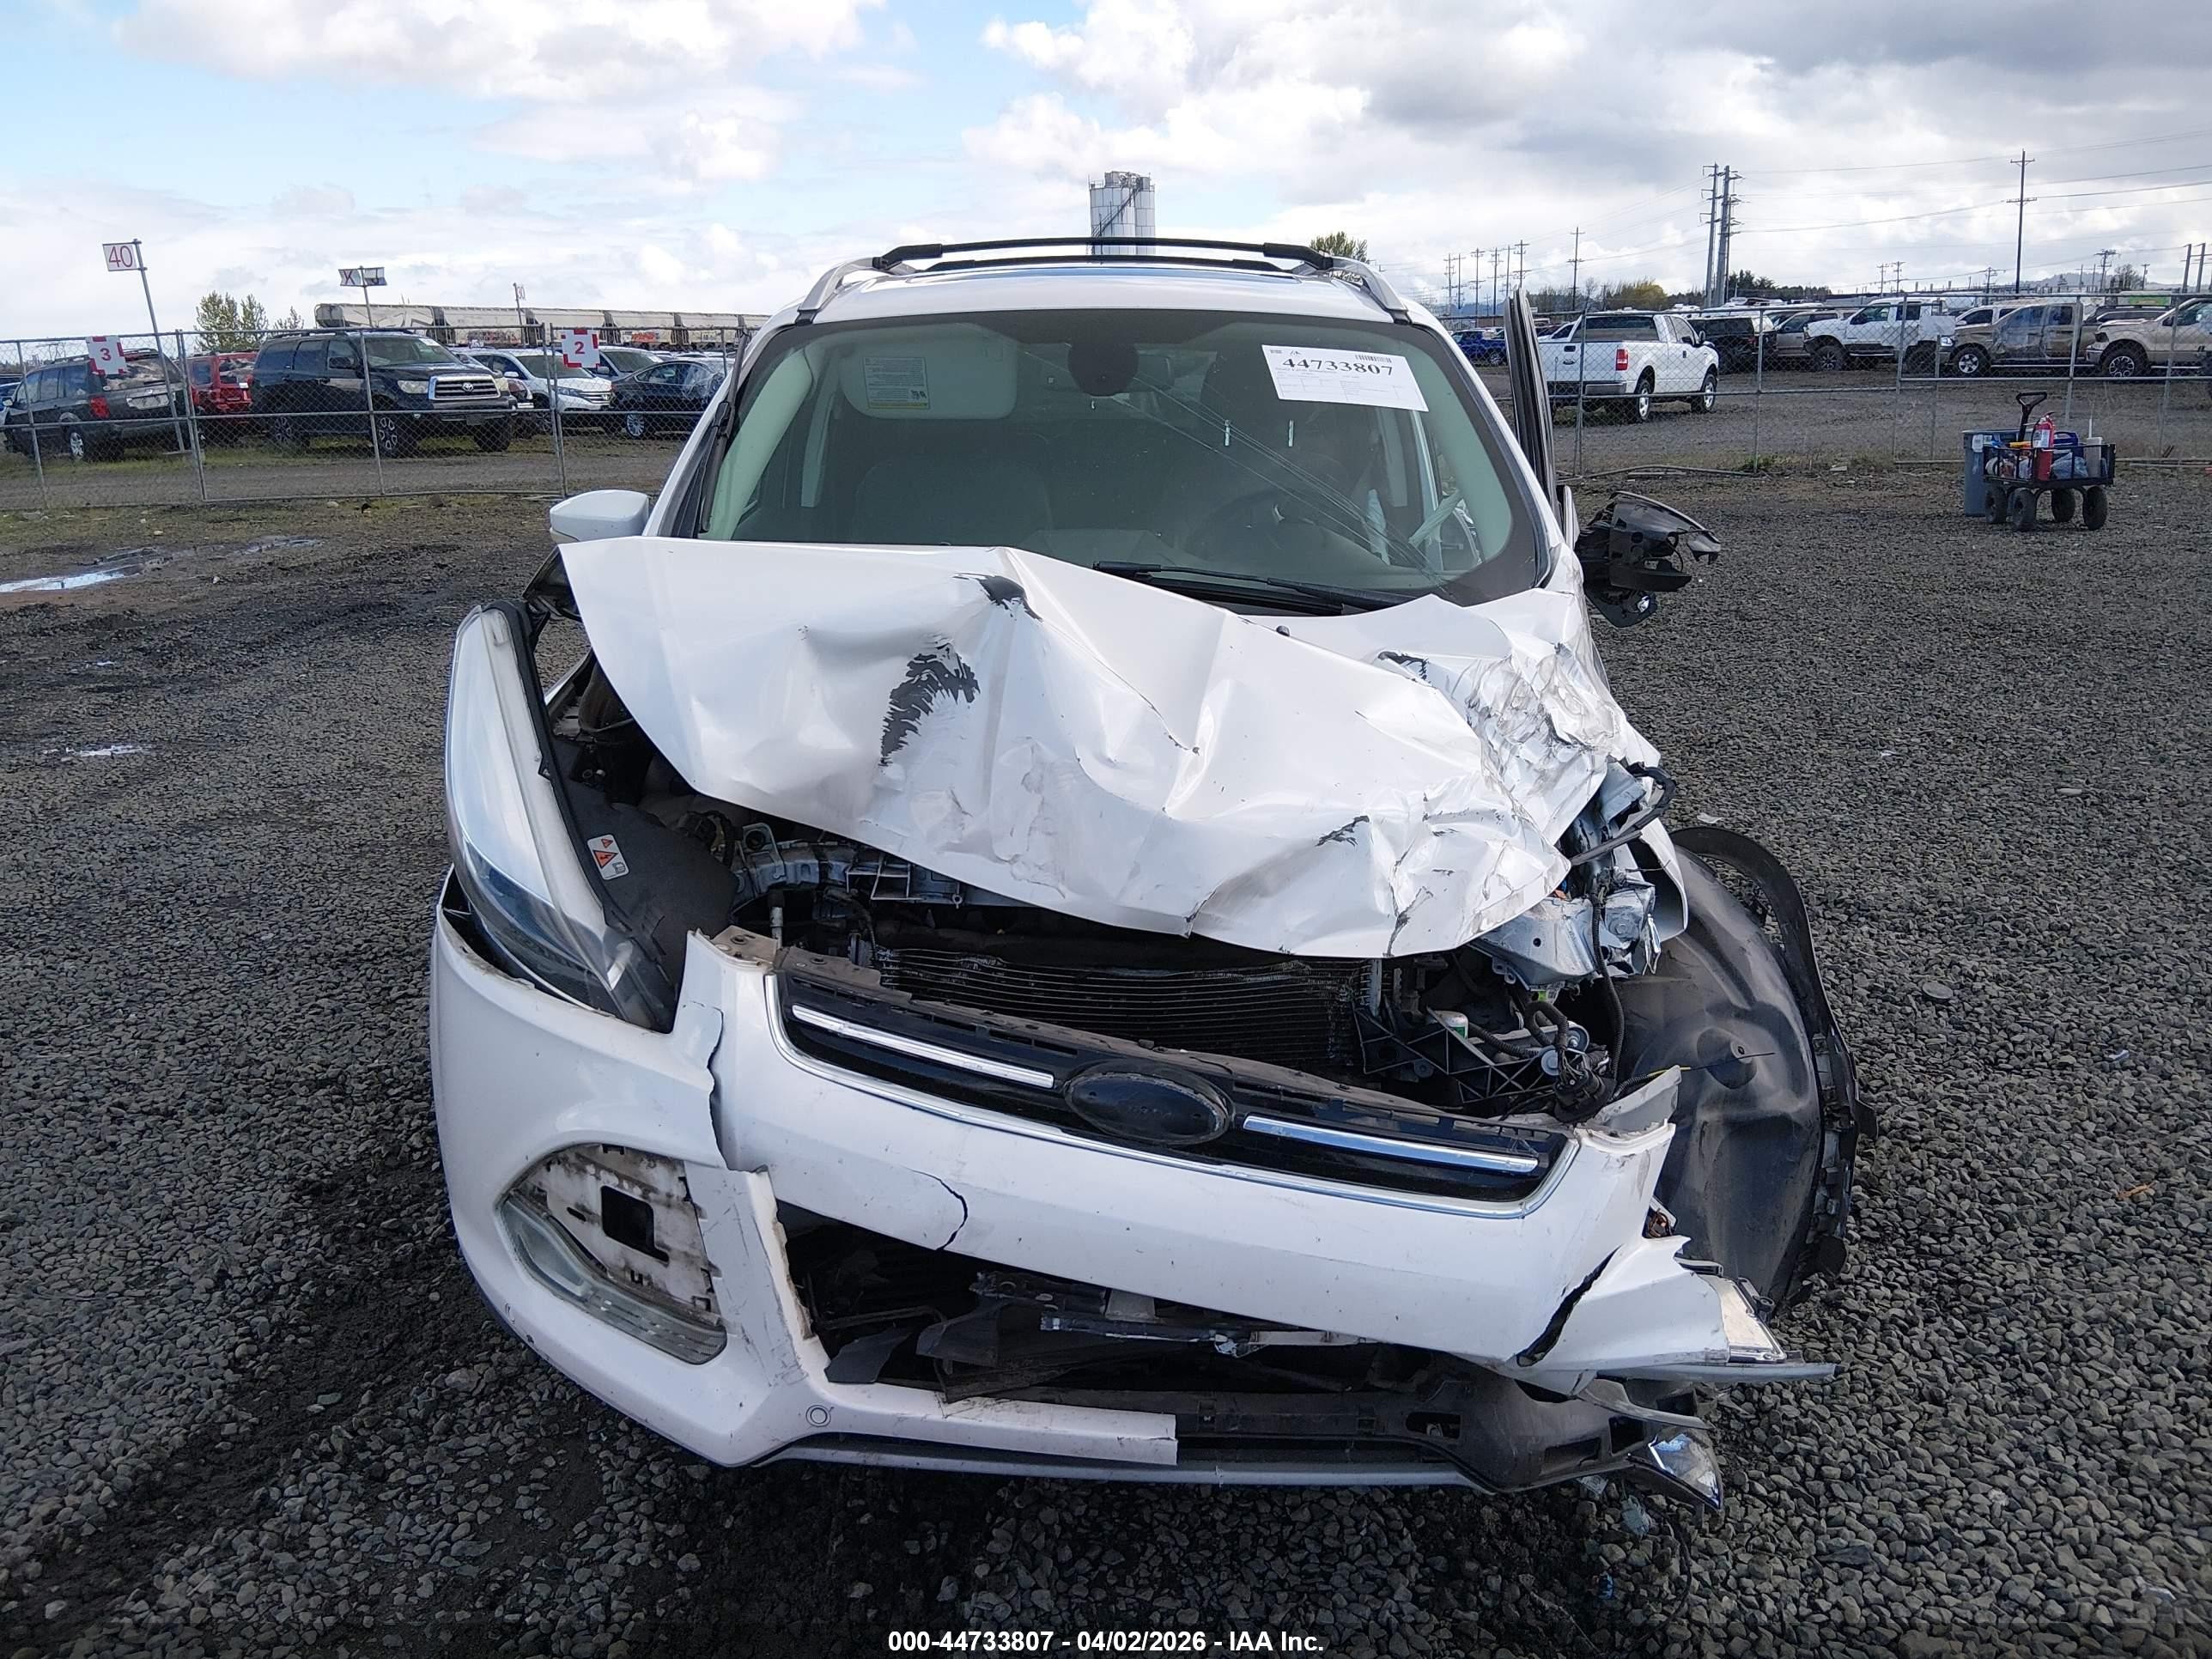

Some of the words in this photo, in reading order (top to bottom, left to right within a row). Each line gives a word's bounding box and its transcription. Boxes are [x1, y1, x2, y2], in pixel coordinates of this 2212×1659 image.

[108, 245, 133, 268] 40
[100, 347, 112, 362] 3
[574, 341, 586, 355] 2
[1282, 358, 1393, 375] 44733807
